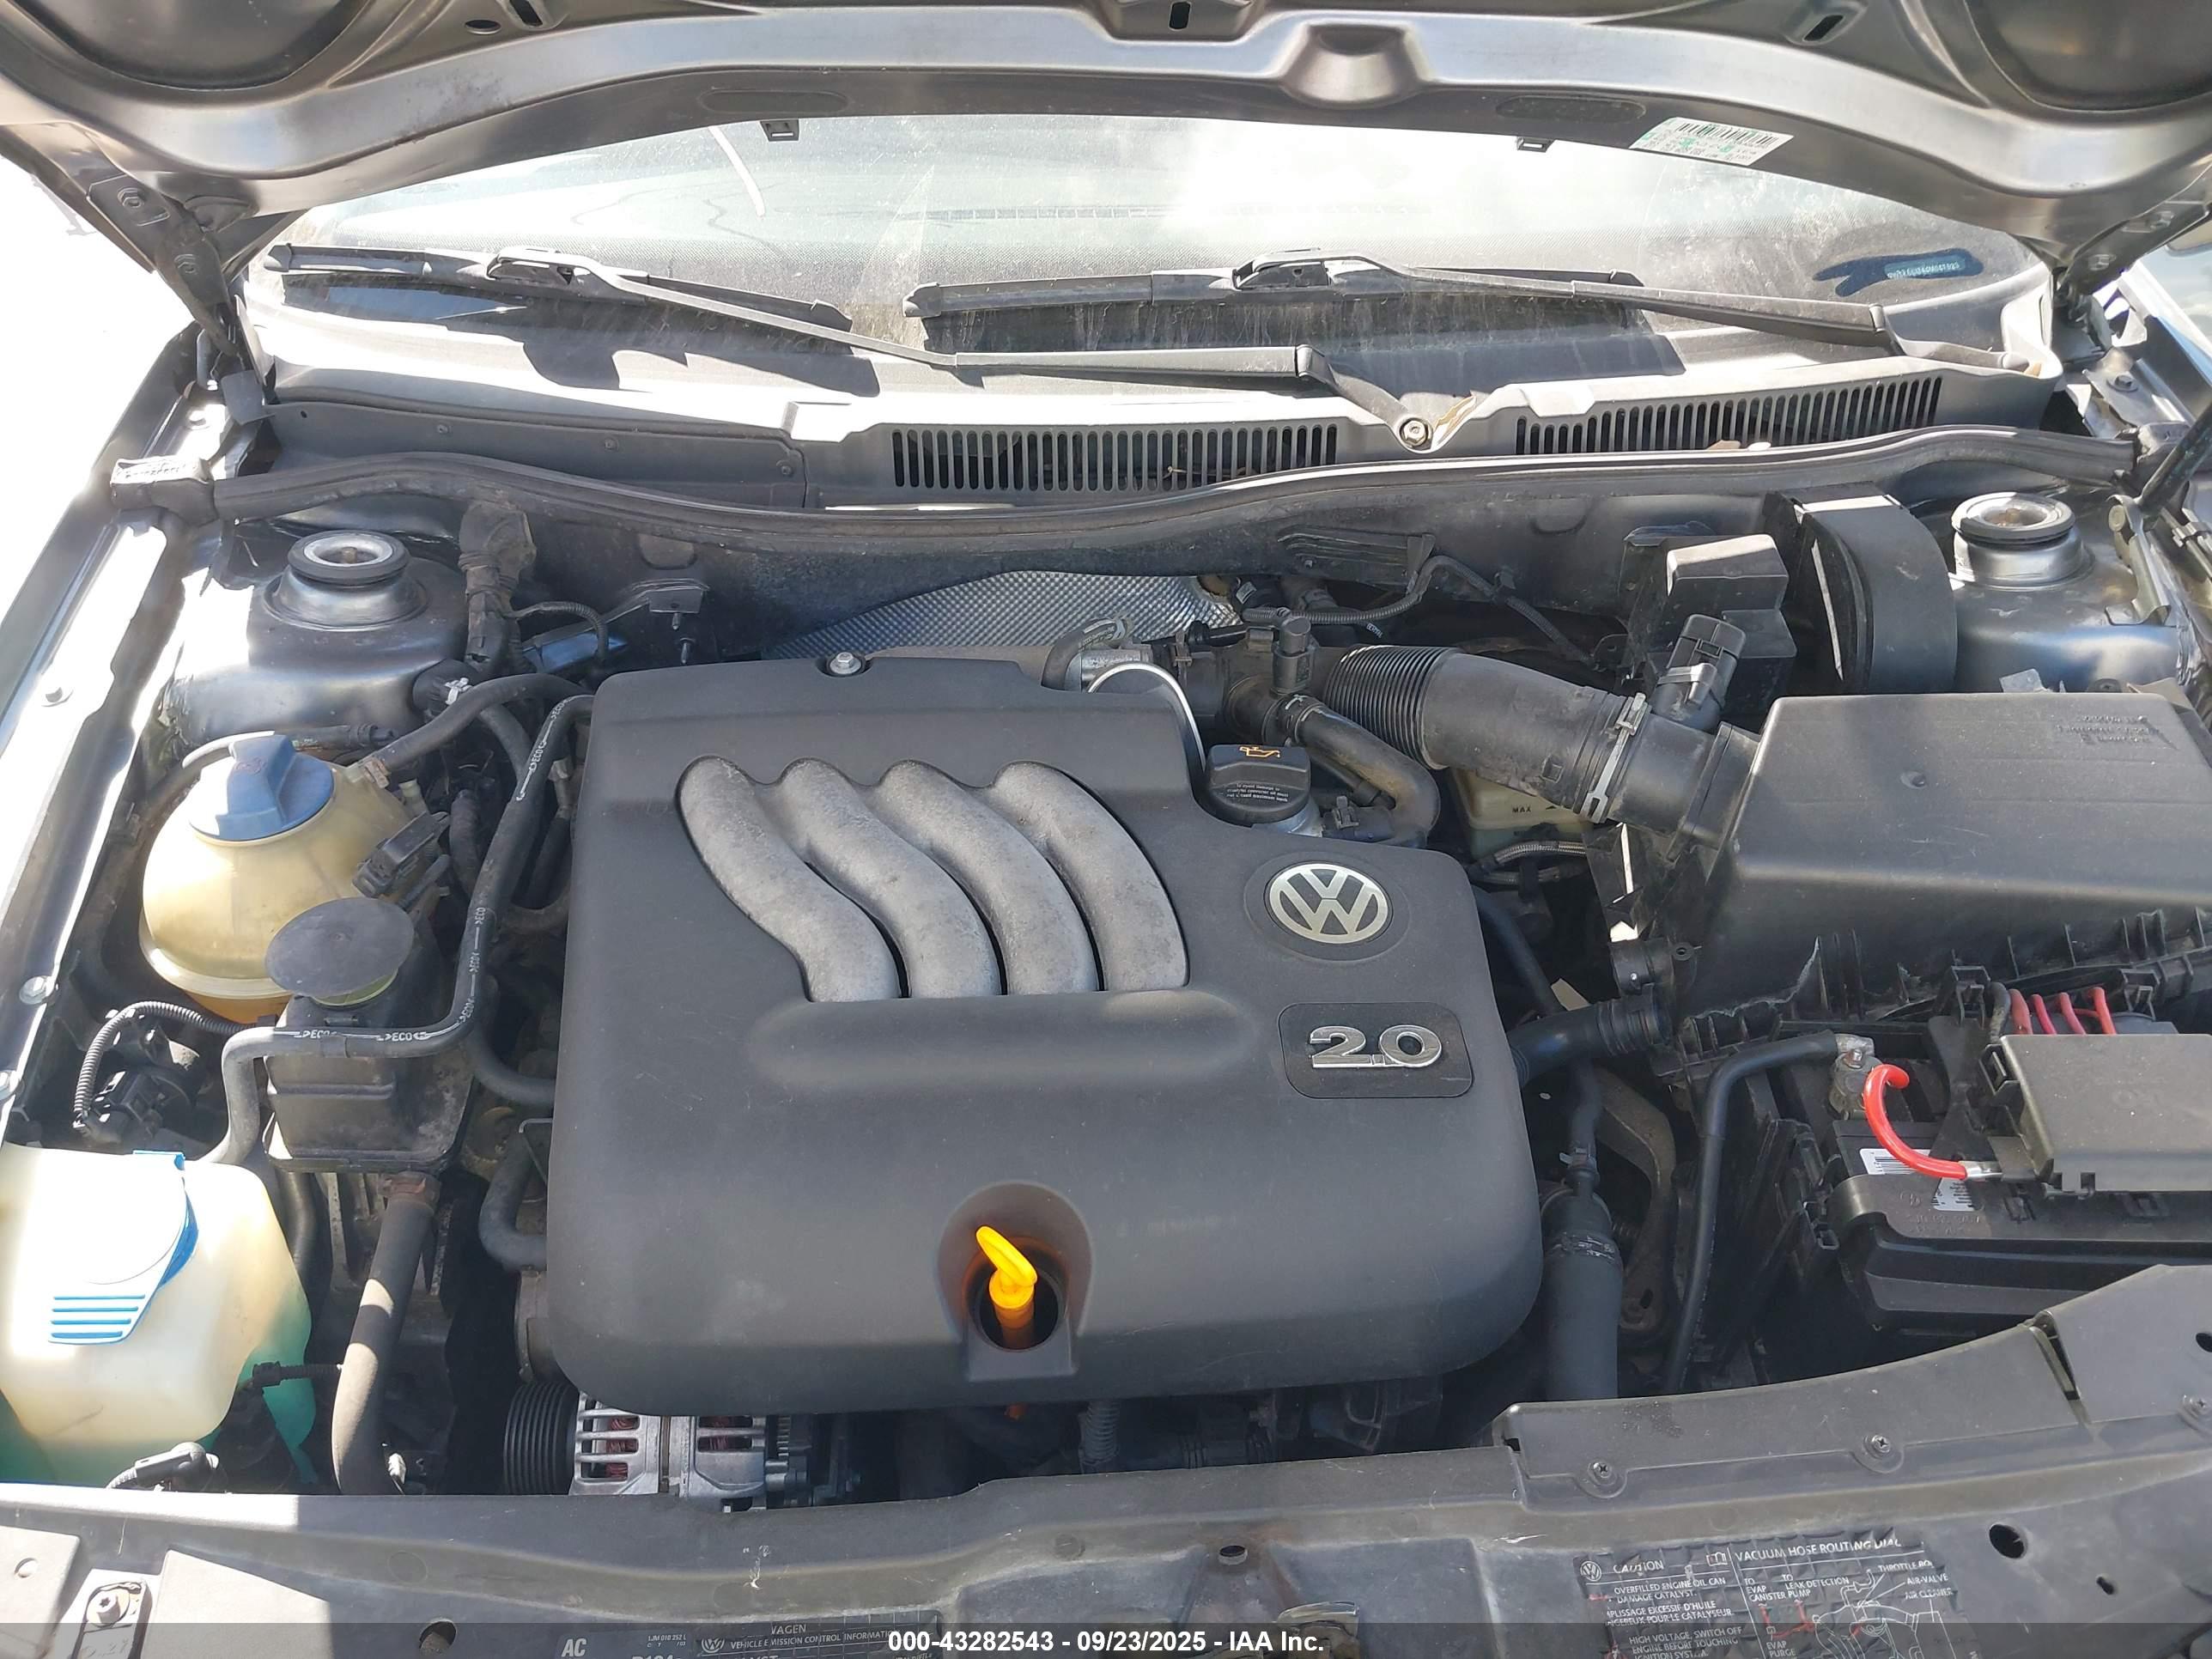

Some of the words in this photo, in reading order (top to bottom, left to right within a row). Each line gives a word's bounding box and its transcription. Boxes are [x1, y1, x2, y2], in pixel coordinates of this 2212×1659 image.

[1310, 1024, 1442, 1067] 2.0
[1735, 1548, 1786, 1561] VACUUM
[1789, 1545, 1817, 1558] HOSE
[1820, 1540, 1872, 1554] ROUTING
[1613, 1560, 1664, 1575] CAUTION
[1877, 1562, 1917, 1572] THROTTLE
[1744, 1577, 1755, 1586] TO
[1781, 1573, 1794, 1582] TO
[1613, 1583, 1661, 1595] OVERFILLED
[1662, 1580, 1692, 1590] ENGINE
[1692, 1578, 1706, 1588] OIL
[1708, 1577, 1727, 1586] CAN
[1785, 1581, 1806, 1591] LEAK
[1806, 1577, 1850, 1588] DETECTION
[1747, 1585, 1767, 1595] EVAP
[1788, 1589, 1811, 1599] PUMP
[1748, 1590, 1786, 1602] CANISTER
[1682, 1600, 1717, 1611] D'HUILE
[1629, 1634, 1651, 1644] HIGH
[1692, 1628, 1726, 1639] SWITCH
[1726, 1626, 1742, 1636] OFF
[561, 1638, 586, 1657] AC
[731, 1639, 763, 1650] VEHICLE
[1694, 1637, 1739, 1648] TOUCHING
[1765, 1640, 1787, 1650] EVAP
